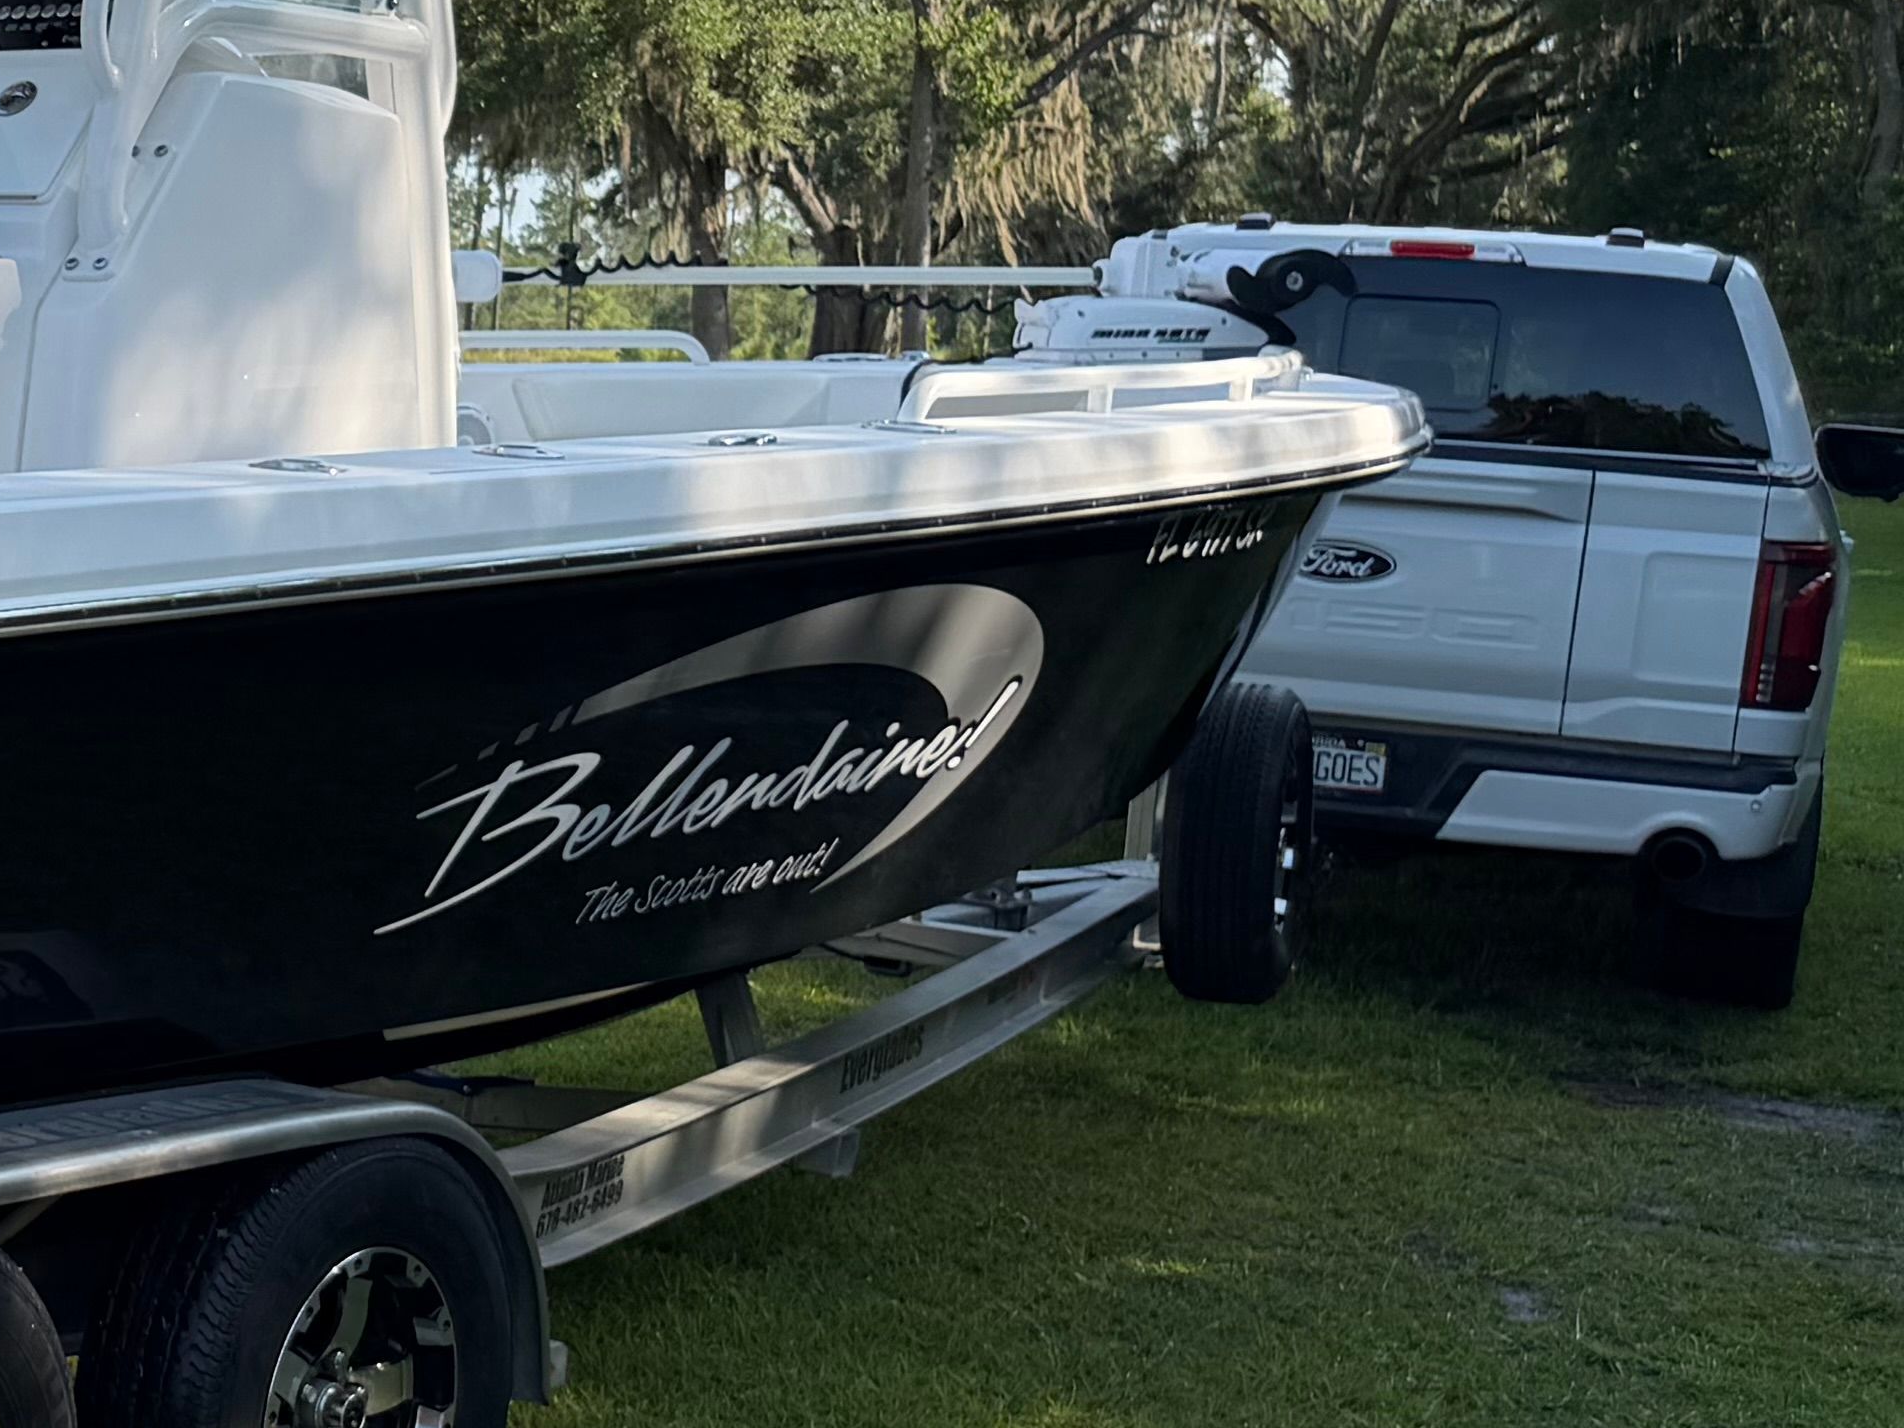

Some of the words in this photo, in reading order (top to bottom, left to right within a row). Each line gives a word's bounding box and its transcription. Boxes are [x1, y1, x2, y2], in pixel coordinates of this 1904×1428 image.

[1300, 545, 1376, 578] Ford
[575, 881, 634, 926] The
[634, 867, 724, 915] Scotts
[721, 860, 772, 897] are
[772, 835, 840, 886] out!
[839, 1024, 925, 1094] Everglades
